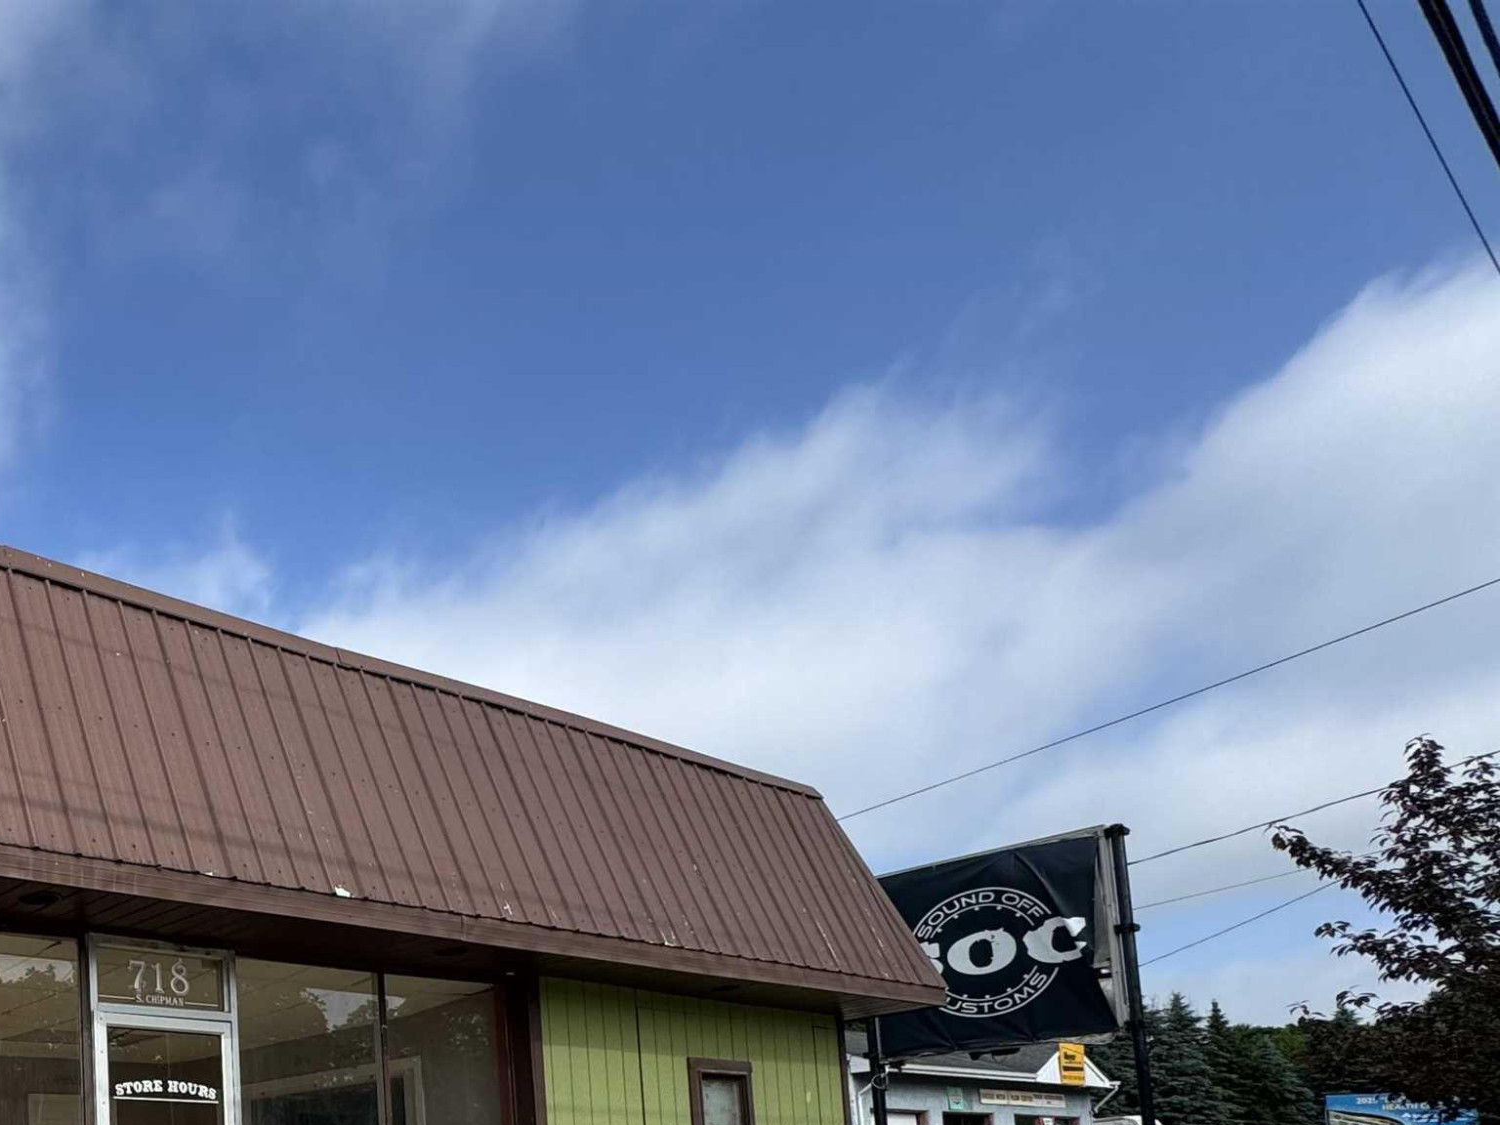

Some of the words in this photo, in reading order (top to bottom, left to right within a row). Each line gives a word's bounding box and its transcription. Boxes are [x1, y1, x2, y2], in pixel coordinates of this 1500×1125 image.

[917, 891, 995, 939] SOUND
[1001, 892, 1044, 919] OFF
[127, 957, 190, 996] 718
[946, 972, 1047, 1014] USTOMS
[145, 994, 185, 1006] CHIPMAN
[115, 1079, 163, 1097] STORE
[167, 1080, 217, 1100] HOURS
